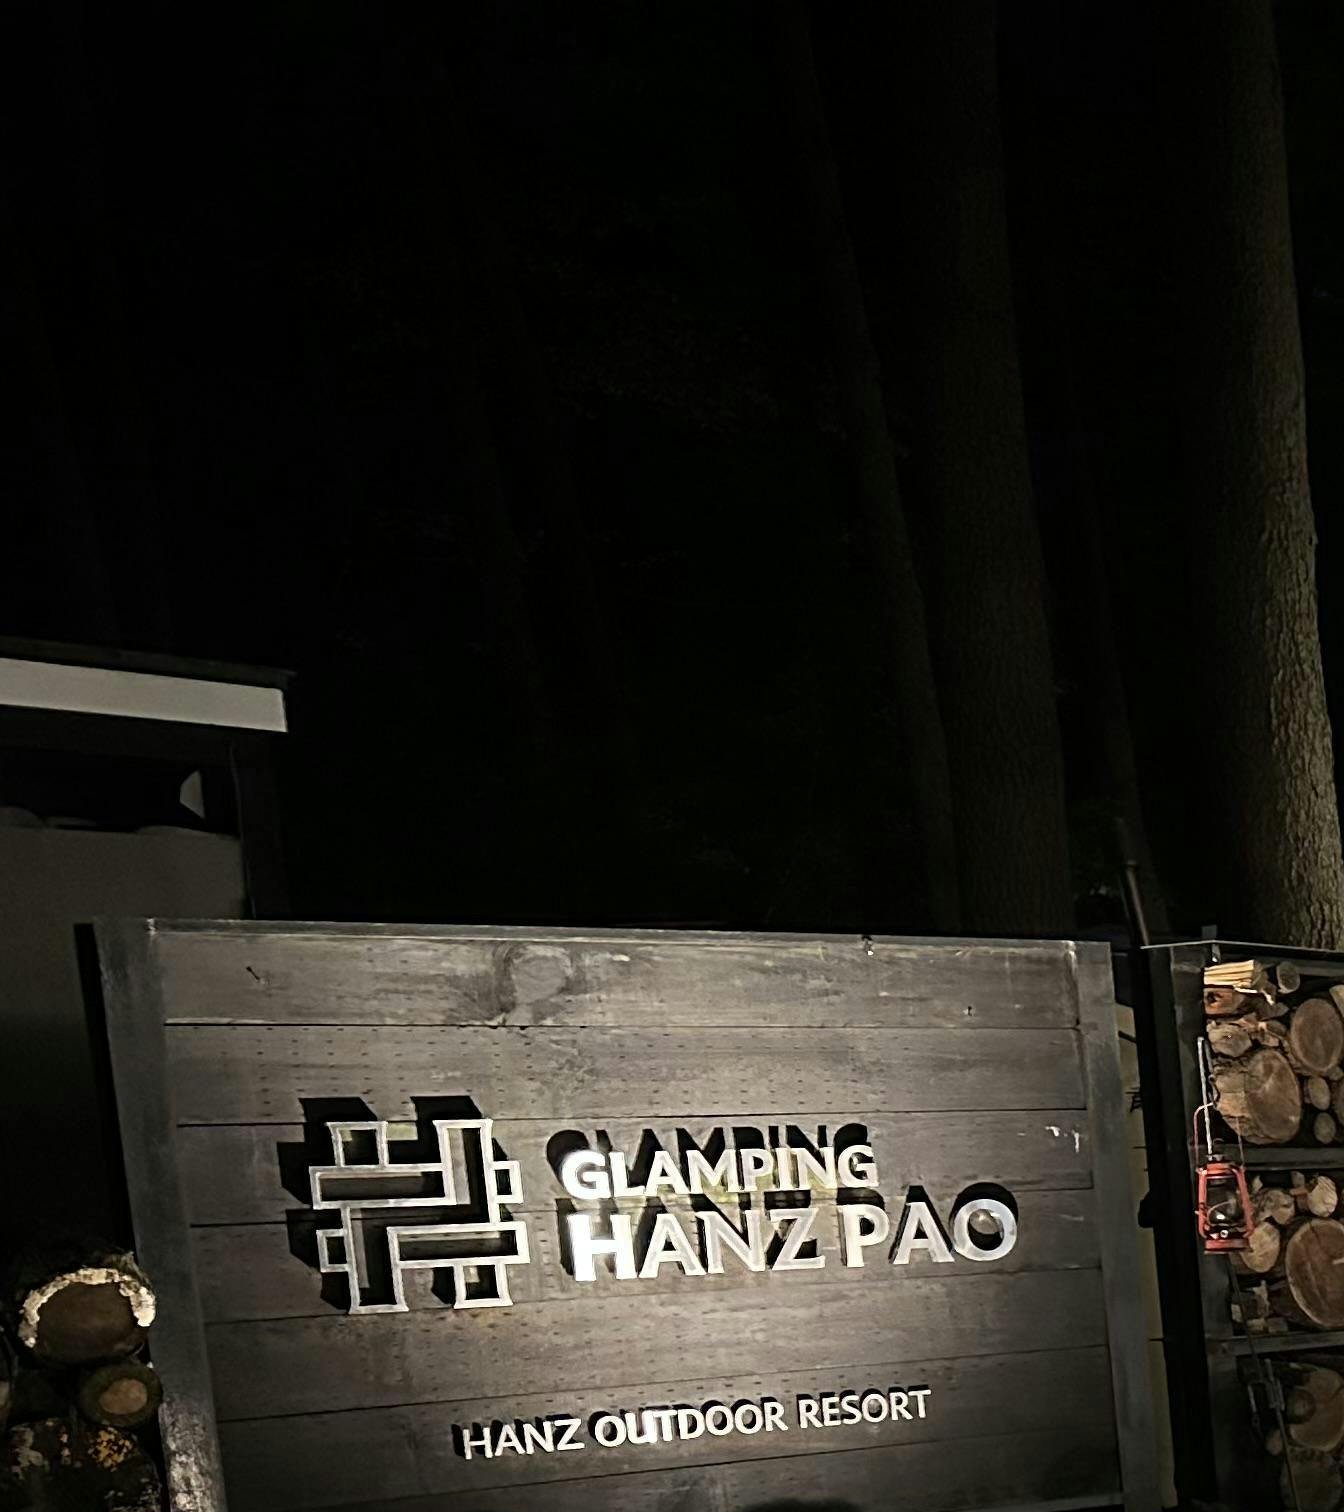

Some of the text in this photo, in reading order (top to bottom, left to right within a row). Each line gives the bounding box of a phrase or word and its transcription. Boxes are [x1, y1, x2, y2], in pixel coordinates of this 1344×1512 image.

[562, 1145, 880, 1199] GLAMPING
[568, 1198, 1018, 1282] HANZ PAO
[463, 1390, 932, 1460] HANZ OUTDOOR RESORT
